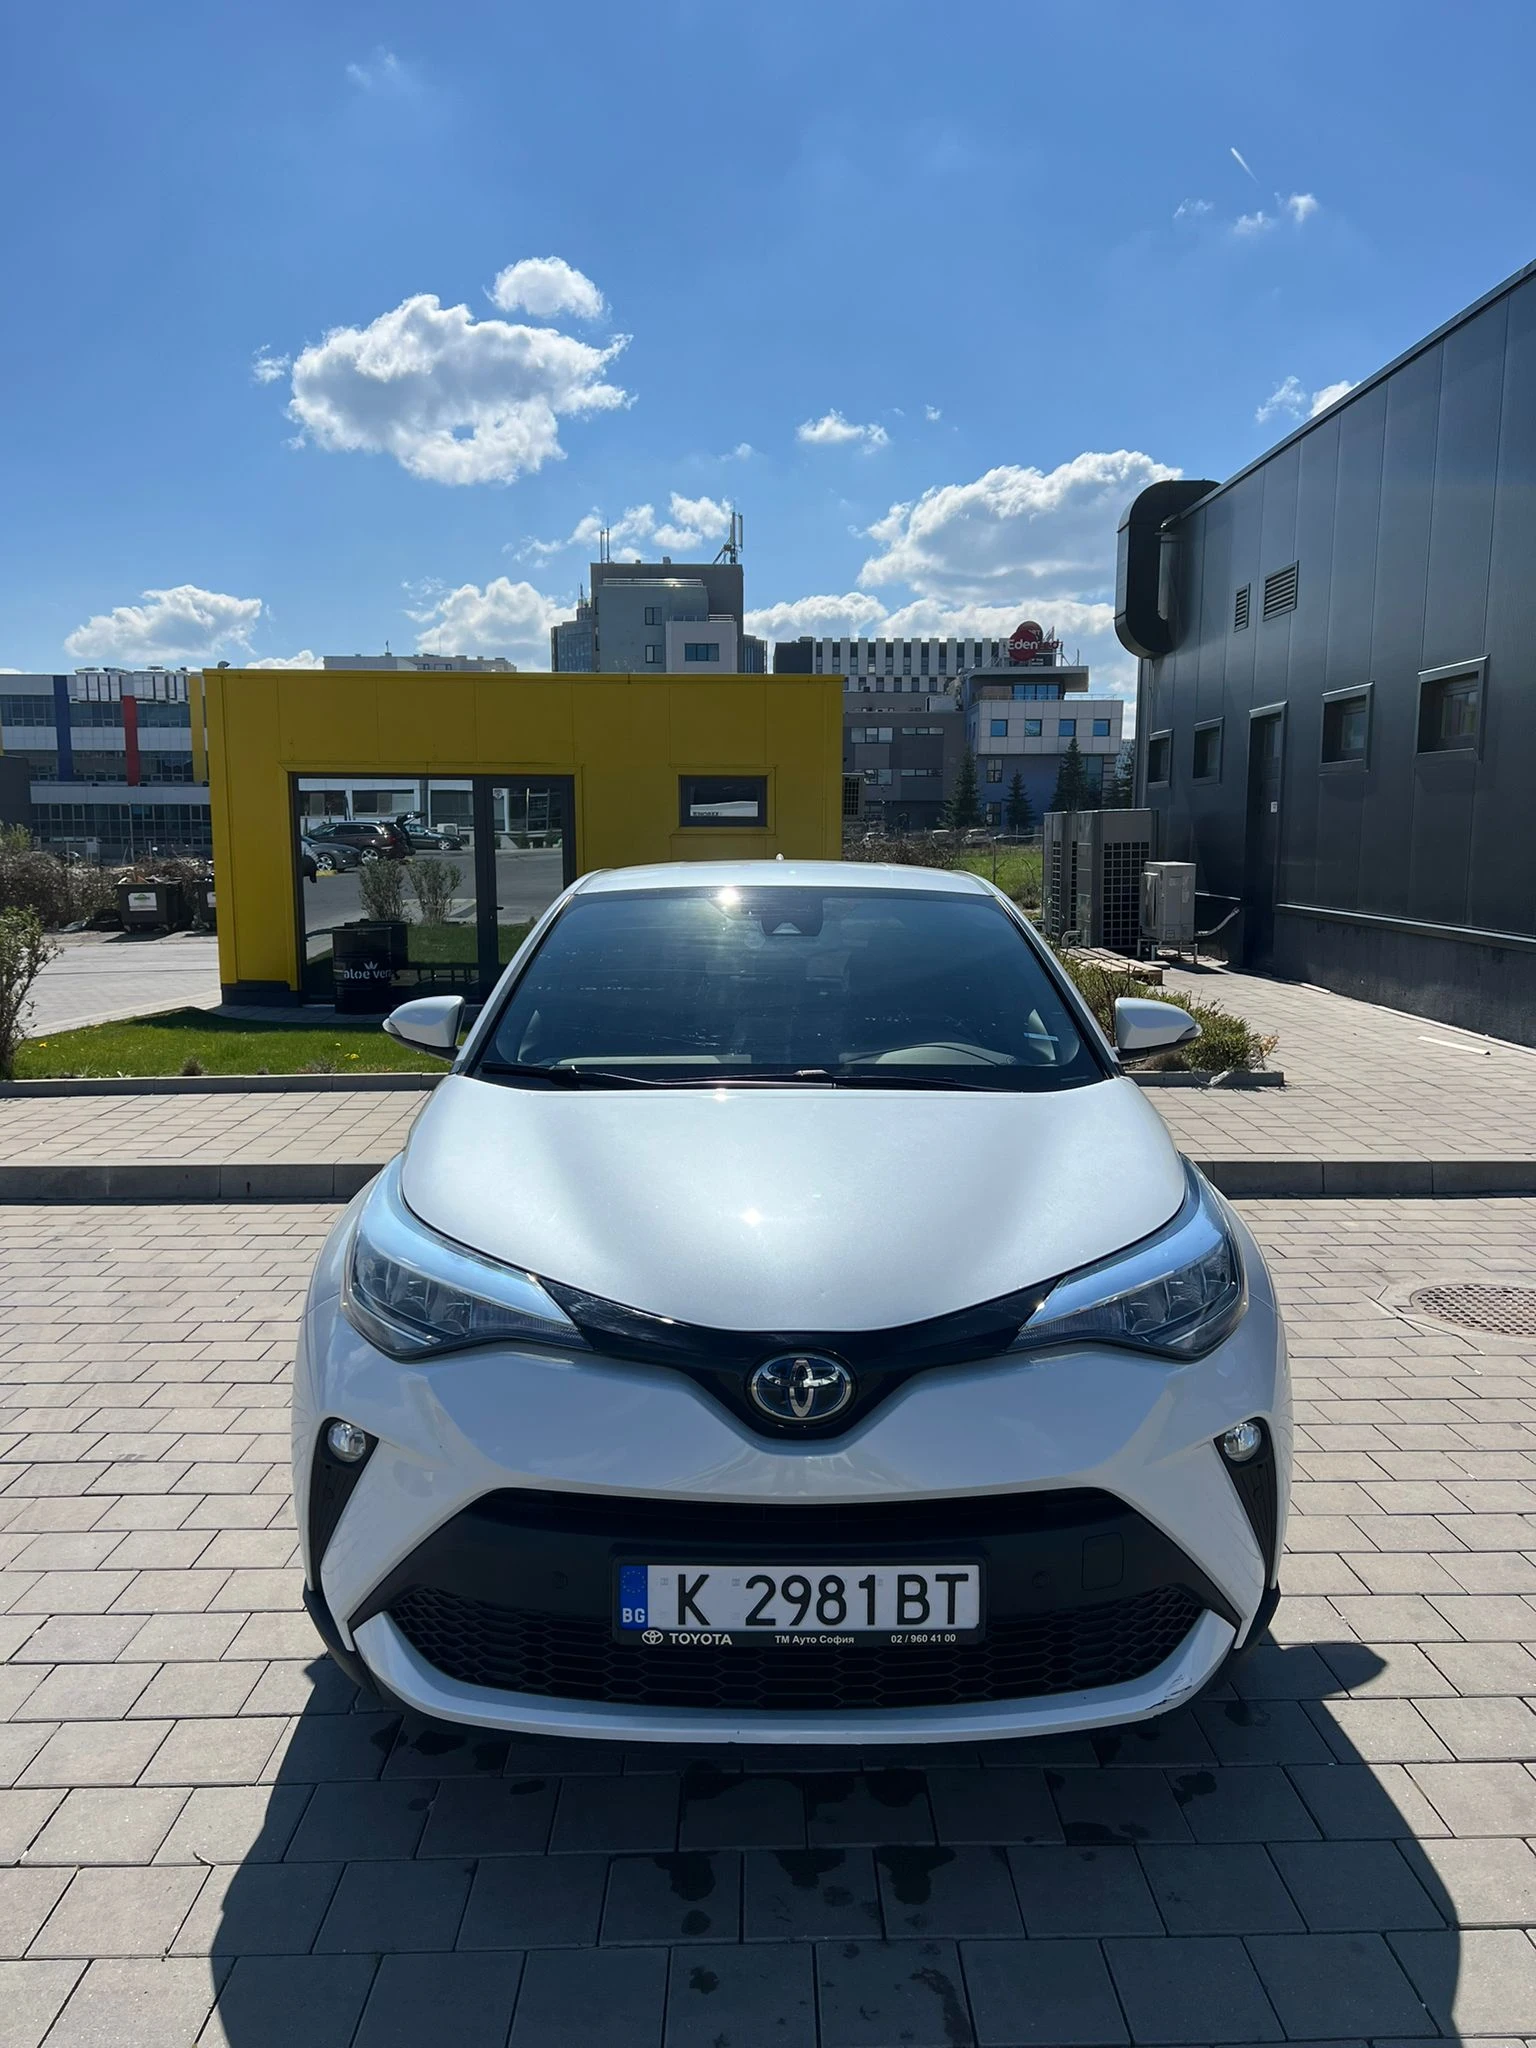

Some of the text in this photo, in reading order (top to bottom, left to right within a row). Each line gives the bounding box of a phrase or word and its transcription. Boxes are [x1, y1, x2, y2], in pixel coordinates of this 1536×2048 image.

[344, 968, 370, 979] aloe
[677, 1572, 969, 1627] K 2981 BT
[622, 1607, 646, 1623] BG
[669, 1632, 732, 1645] TOYOTA
[792, 1634, 817, 1646] Ауто
[819, 1634, 855, 1646] София
[890, 1633, 956, 1643] 02 / 960 41 00
